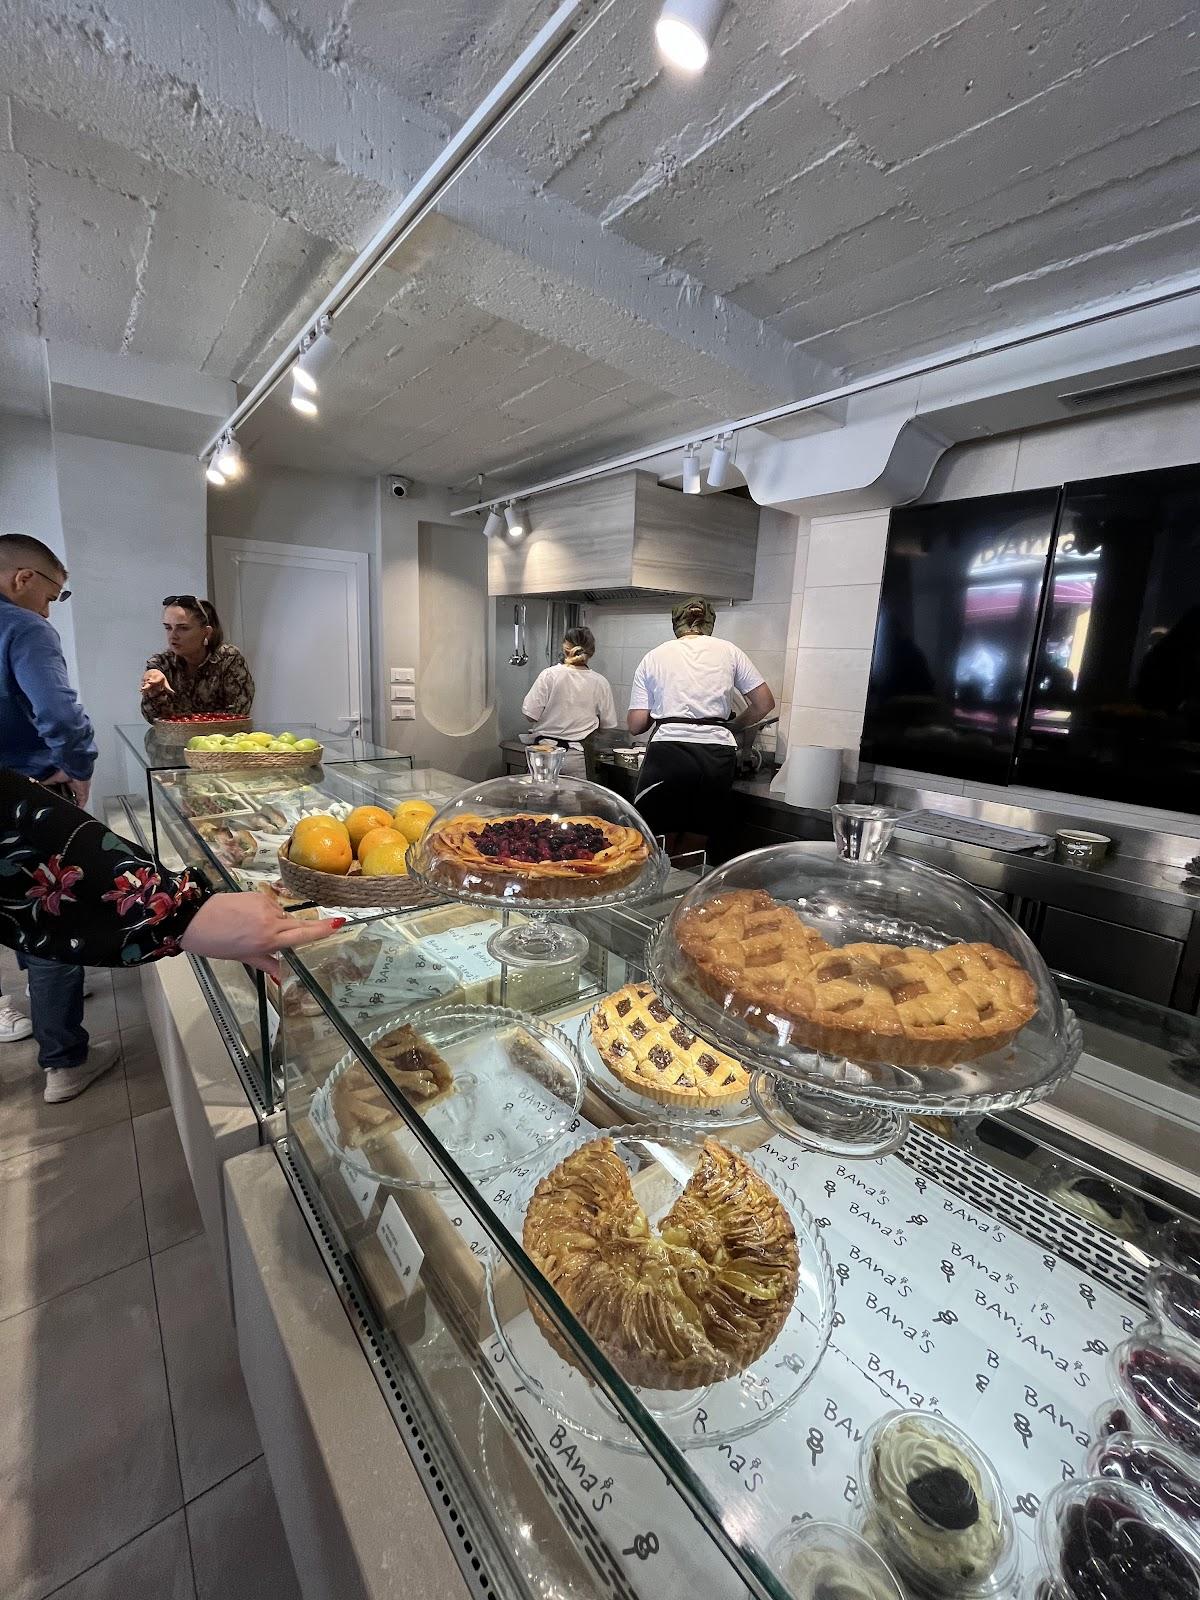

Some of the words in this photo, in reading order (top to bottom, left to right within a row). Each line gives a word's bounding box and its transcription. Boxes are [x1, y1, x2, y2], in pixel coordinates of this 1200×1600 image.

[376, 947, 398, 984] BAna's
[518, 1088, 557, 1121] BAna's
[759, 1143, 799, 1171] Ana's
[836, 1164, 890, 1206] BAna's
[849, 1202, 908, 1247] BAna's
[943, 1199, 1006, 1243] BAna's
[850, 1245, 913, 1298] BAna's
[951, 1241, 1019, 1294] BAna's
[865, 1292, 935, 1354] BAna's
[1024, 1384, 1091, 1448] BAna
[549, 1424, 613, 1511] BAna's
[718, 1443, 764, 1493] na's
